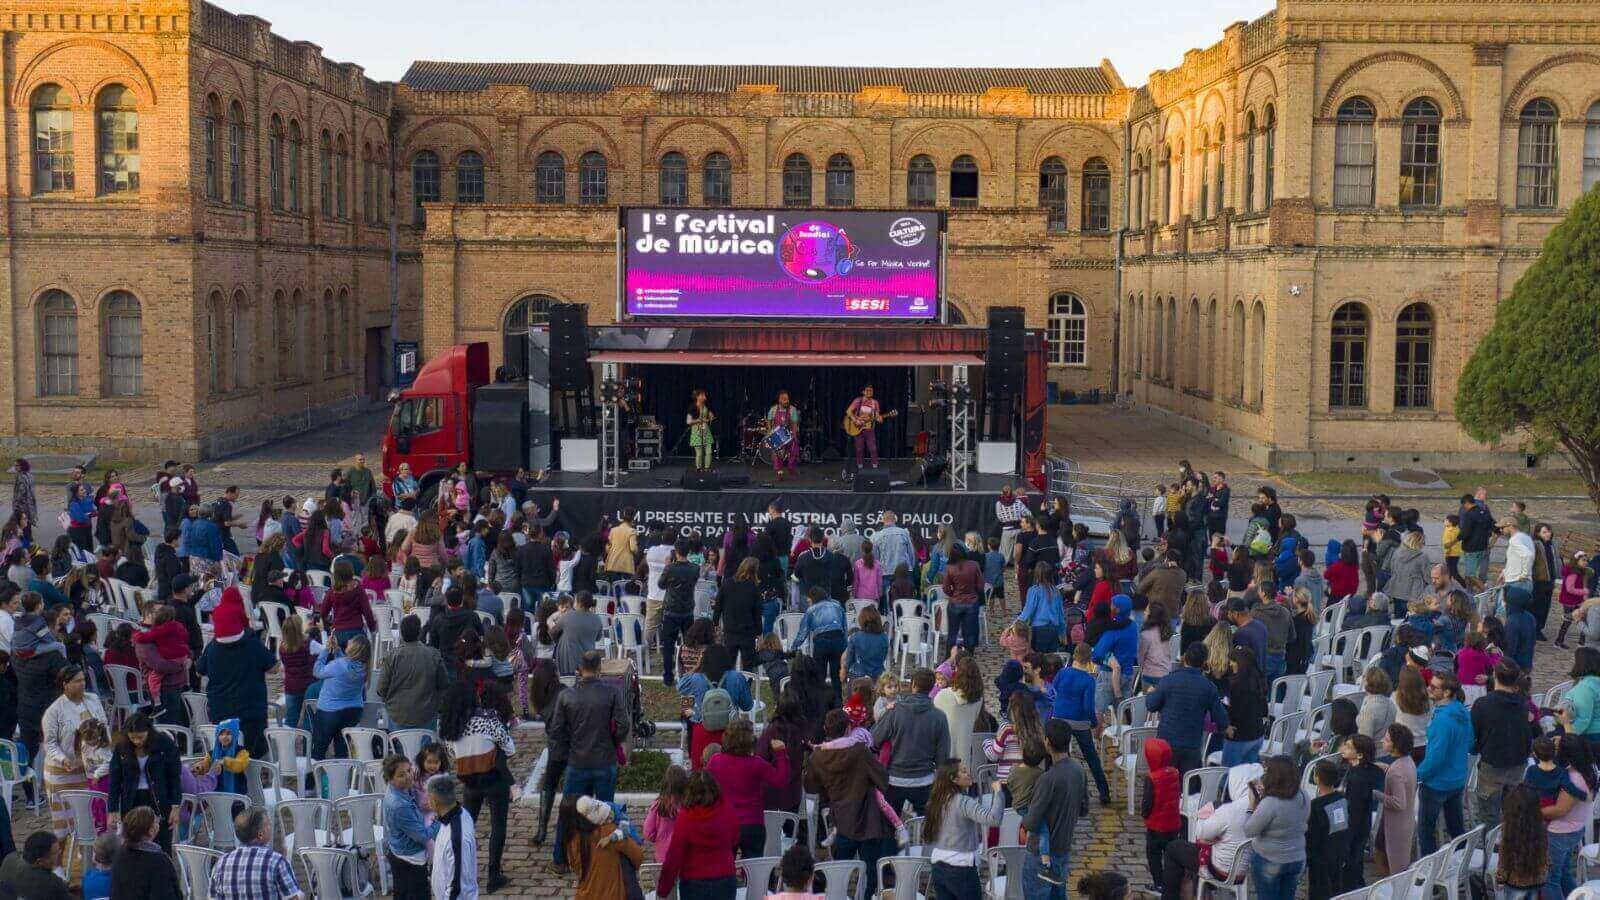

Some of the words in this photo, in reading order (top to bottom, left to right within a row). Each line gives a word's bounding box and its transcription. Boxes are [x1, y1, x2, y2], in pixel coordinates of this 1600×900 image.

[675, 213, 775, 233] Festival
[889, 224, 926, 238] CULTURA
[635, 233, 670, 253] de
[678, 234, 775, 254] Música
[850, 299, 886, 310] SESI
[645, 511, 723, 524] PRESENTE
[753, 509, 838, 525] INÚSTRIA
[841, 512, 863, 525] DE
[866, 510, 898, 525] SÃ
[902, 513, 954, 525] PAULO
[680, 525, 702, 538] OS
